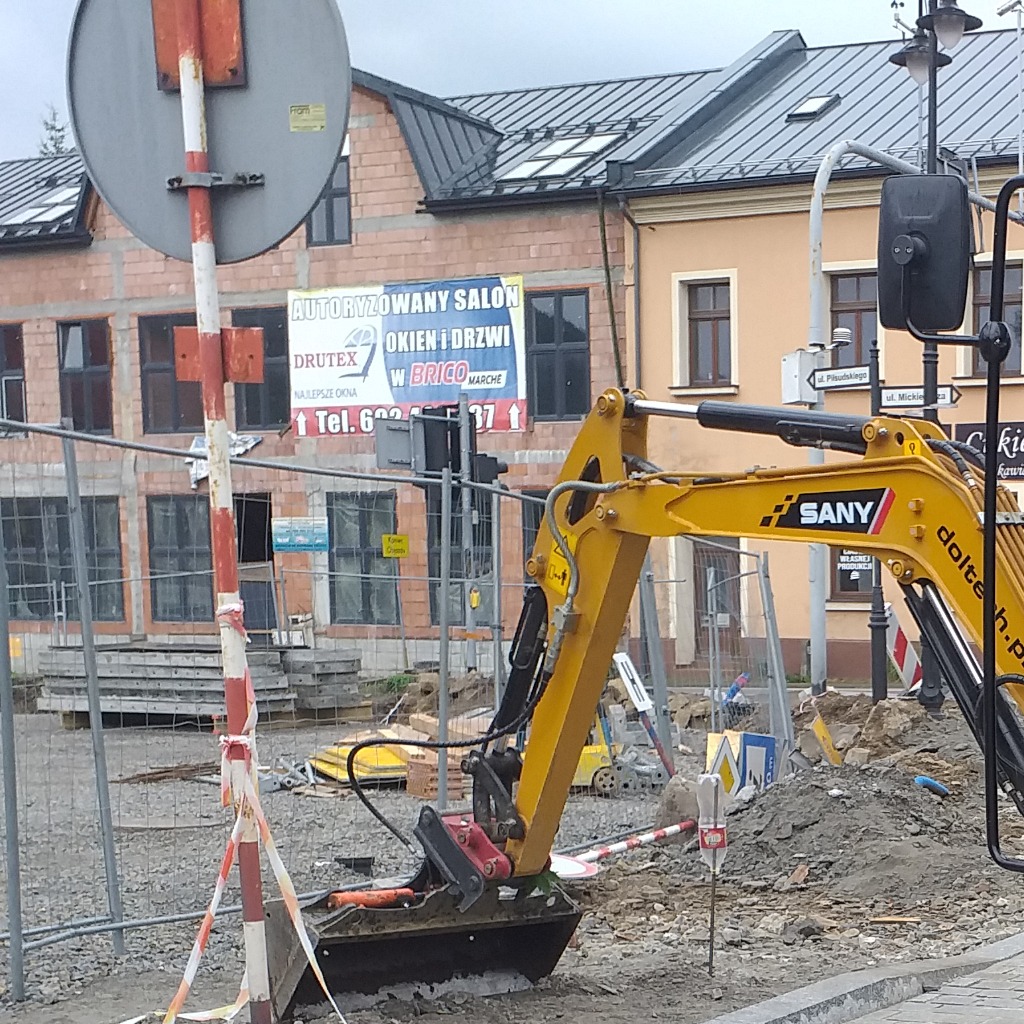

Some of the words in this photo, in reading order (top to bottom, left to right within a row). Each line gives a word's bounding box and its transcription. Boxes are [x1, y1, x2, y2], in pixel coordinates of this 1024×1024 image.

[291, 288, 449, 321] AUTORYZOWANY
[454, 285, 519, 311] SALON
[385, 328, 437, 353] OKIEN
[441, 326, 447, 350] i
[451, 324, 510, 350] DRZWI
[294, 351, 358, 369] DRUTEX
[410, 360, 470, 386] BRICO
[817, 374, 825, 383] ul.
[826, 371, 867, 383] Piłsudskiego
[294, 389, 334, 400] NAJLEPSZE
[335, 387, 358, 399] OKNA
[886, 394, 896, 402] ul.
[898, 392, 946, 402] Mickieza
[315, 408, 355, 434] Tel.
[800, 501, 875, 524] SANY
